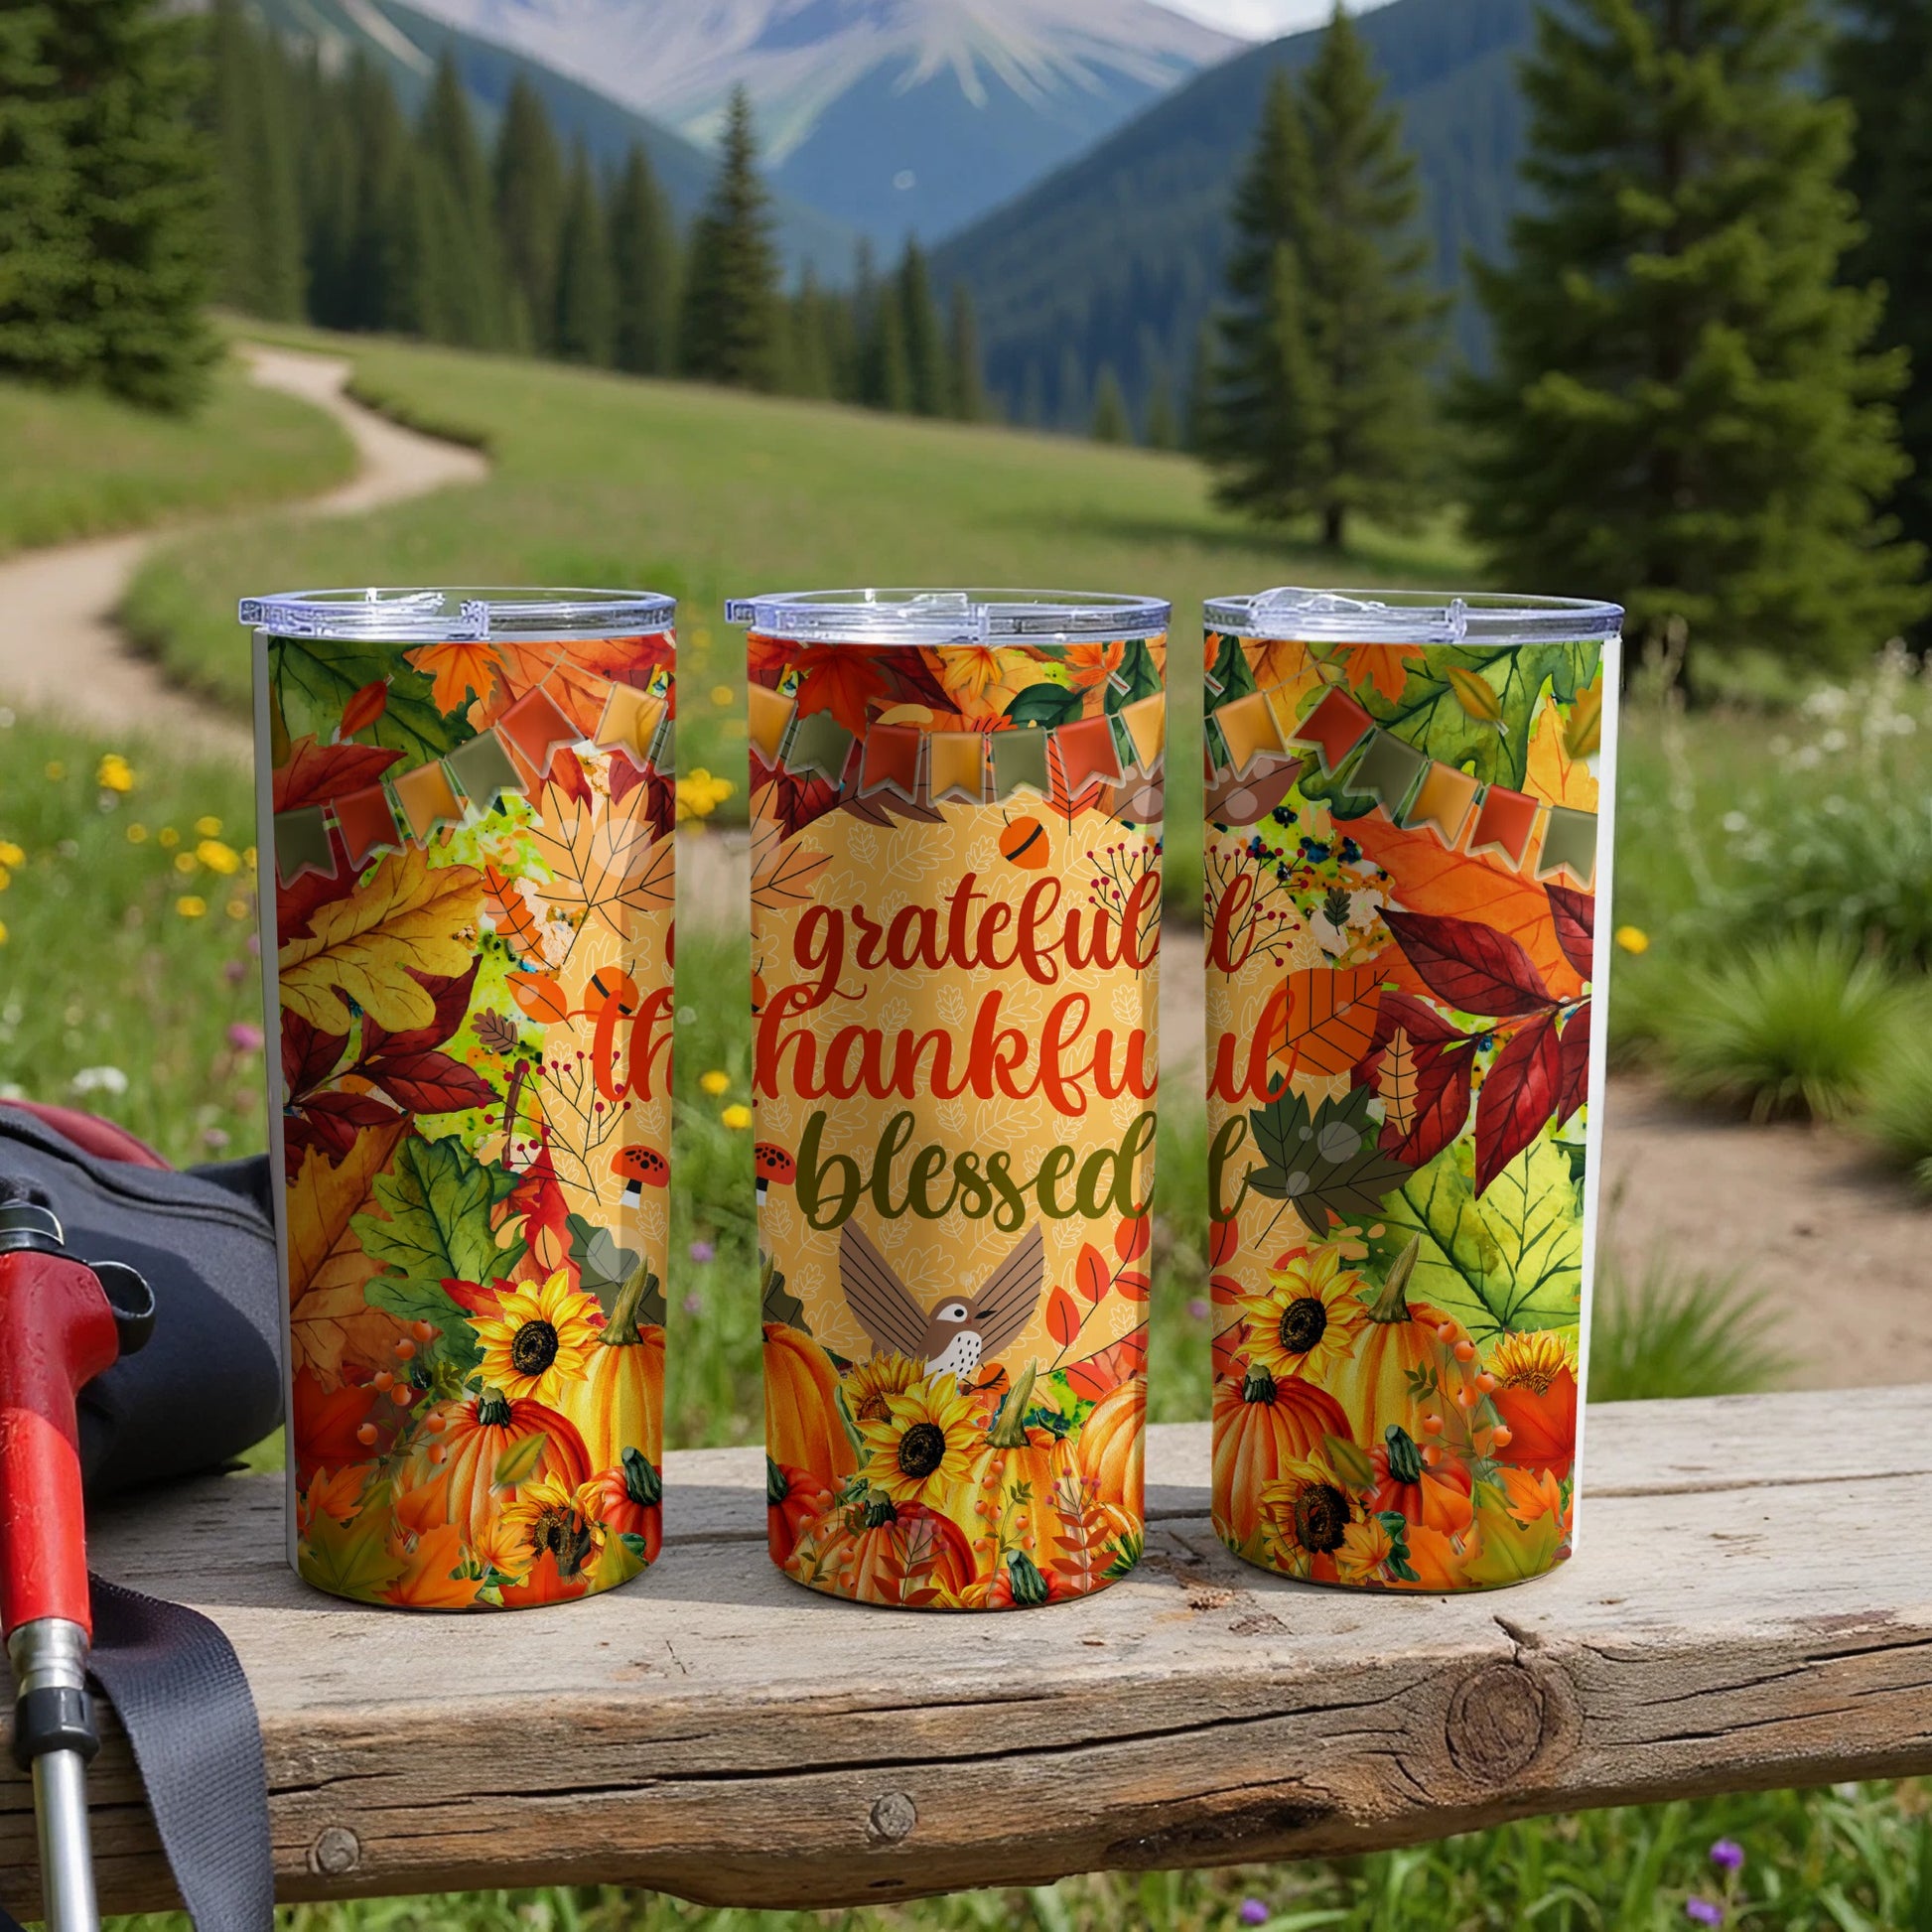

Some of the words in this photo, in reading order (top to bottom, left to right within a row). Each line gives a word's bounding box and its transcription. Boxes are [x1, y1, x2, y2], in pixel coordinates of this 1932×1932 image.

[793, 872, 1161, 1011] grateful
[751, 990, 1160, 1117] hankfu
[795, 1110, 1158, 1232] blessed
